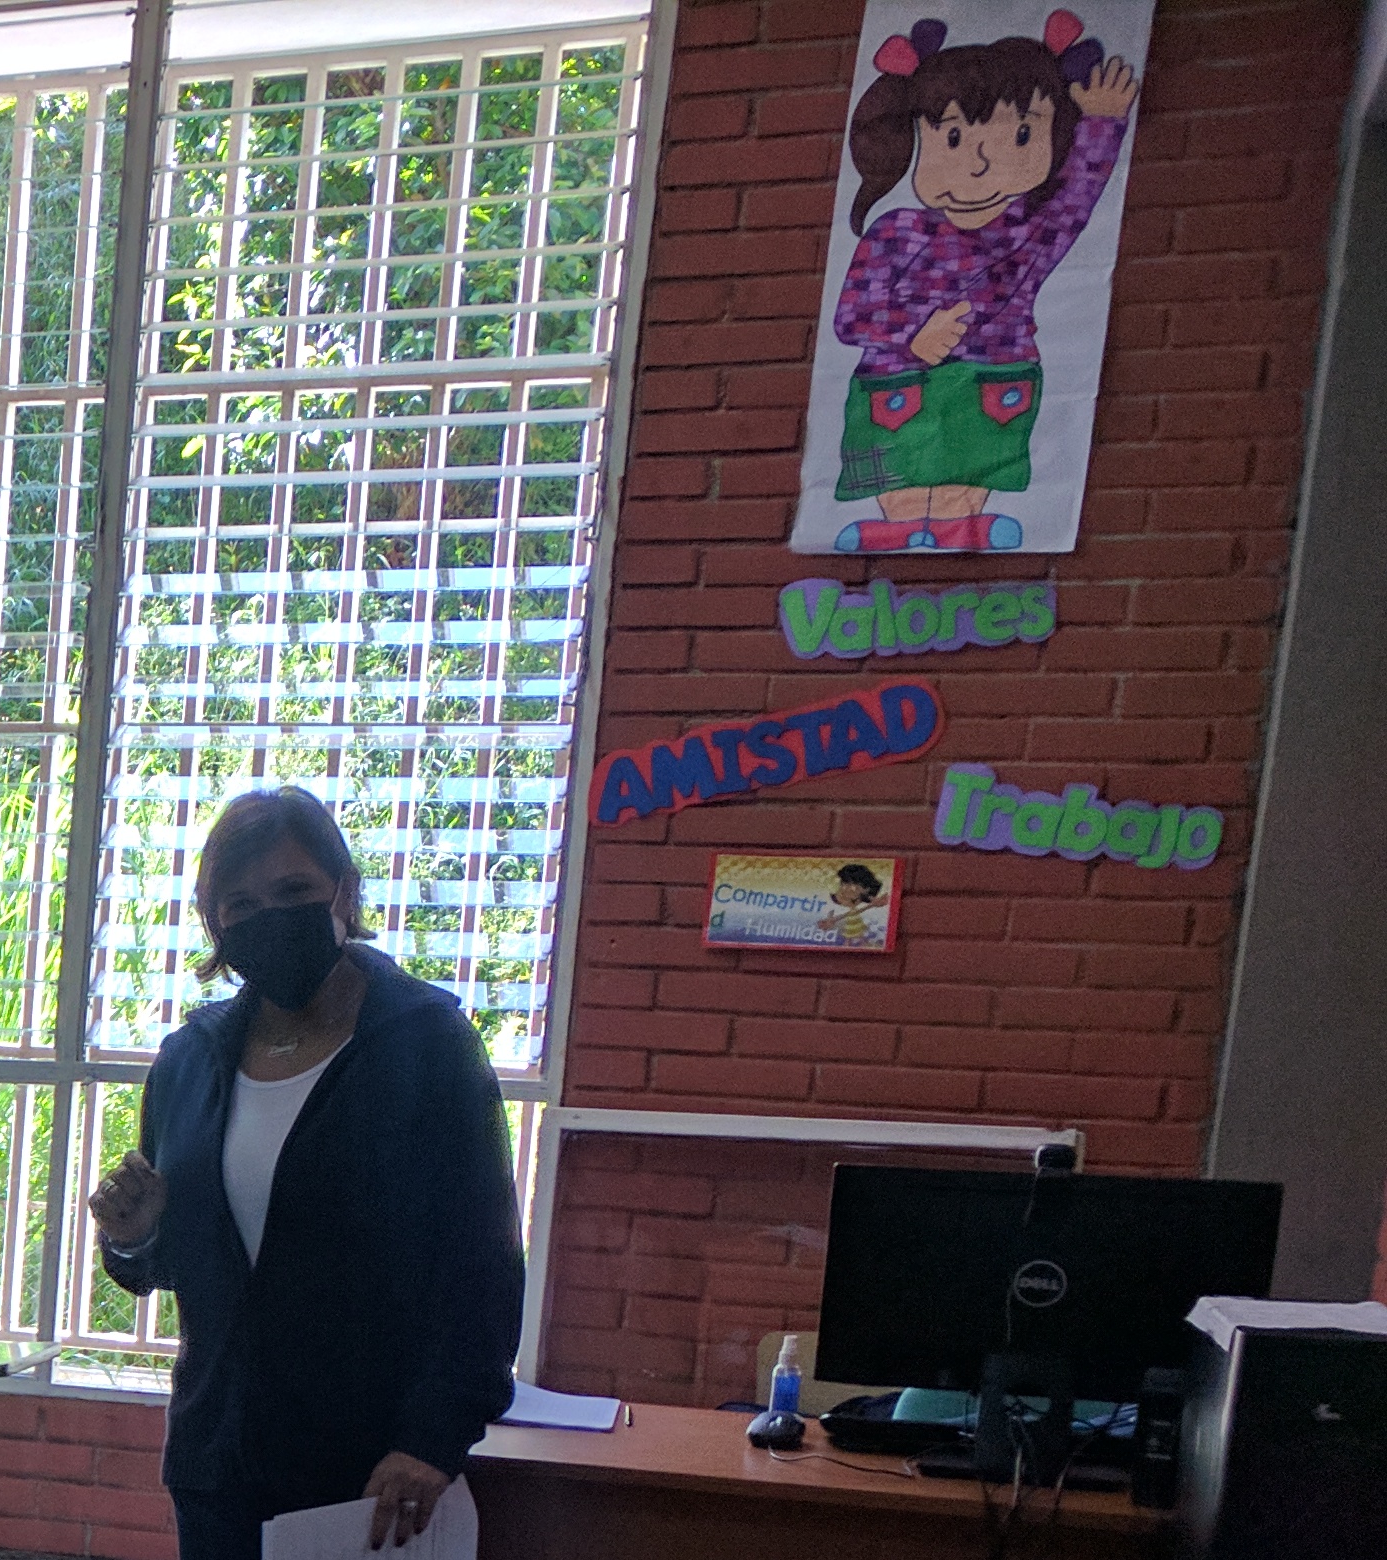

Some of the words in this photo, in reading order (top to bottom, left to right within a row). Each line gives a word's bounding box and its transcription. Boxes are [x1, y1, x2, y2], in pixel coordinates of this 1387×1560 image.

[781, 580, 1056, 655] Valores
[598, 684, 935, 823] AMISTAD
[943, 768, 1224, 869] Trabajo
[714, 883, 828, 912] Compartir
[744, 917, 839, 943] Humildad
